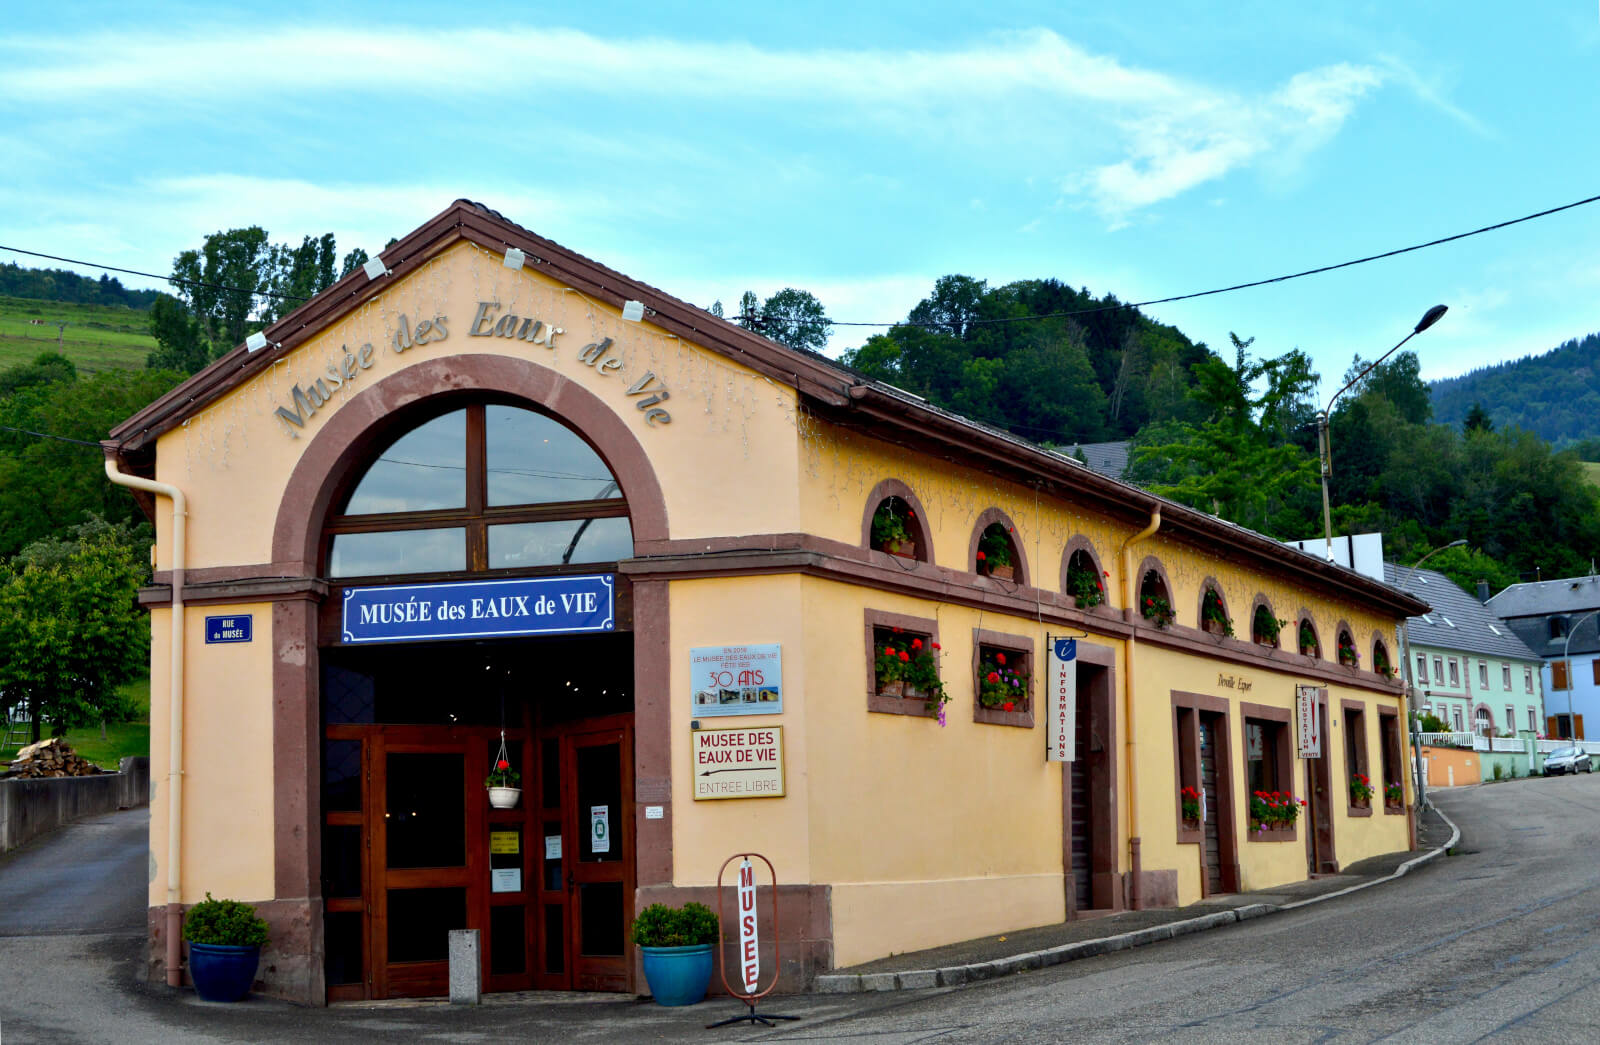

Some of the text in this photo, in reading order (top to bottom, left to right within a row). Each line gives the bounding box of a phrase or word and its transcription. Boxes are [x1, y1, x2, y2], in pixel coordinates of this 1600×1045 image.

[273, 301, 672, 439] Musée des Eaux de Vie
[360, 592, 598, 625] MUSÉE des EAUX de VIE
[222, 619, 235, 628] RUE
[222, 628, 244, 639] MUSÉE
[708, 669, 764, 688] 30 ANS
[1059, 663, 1067, 758] INFORMATIONS
[1301, 691, 1309, 749] DEGUSTATION
[700, 732, 774, 747] MUSEE DES
[699, 748, 777, 764] EAUX DE VIE
[699, 780, 777, 793] ENTREE LIBRE
[740, 866, 758, 987] MUSEE
